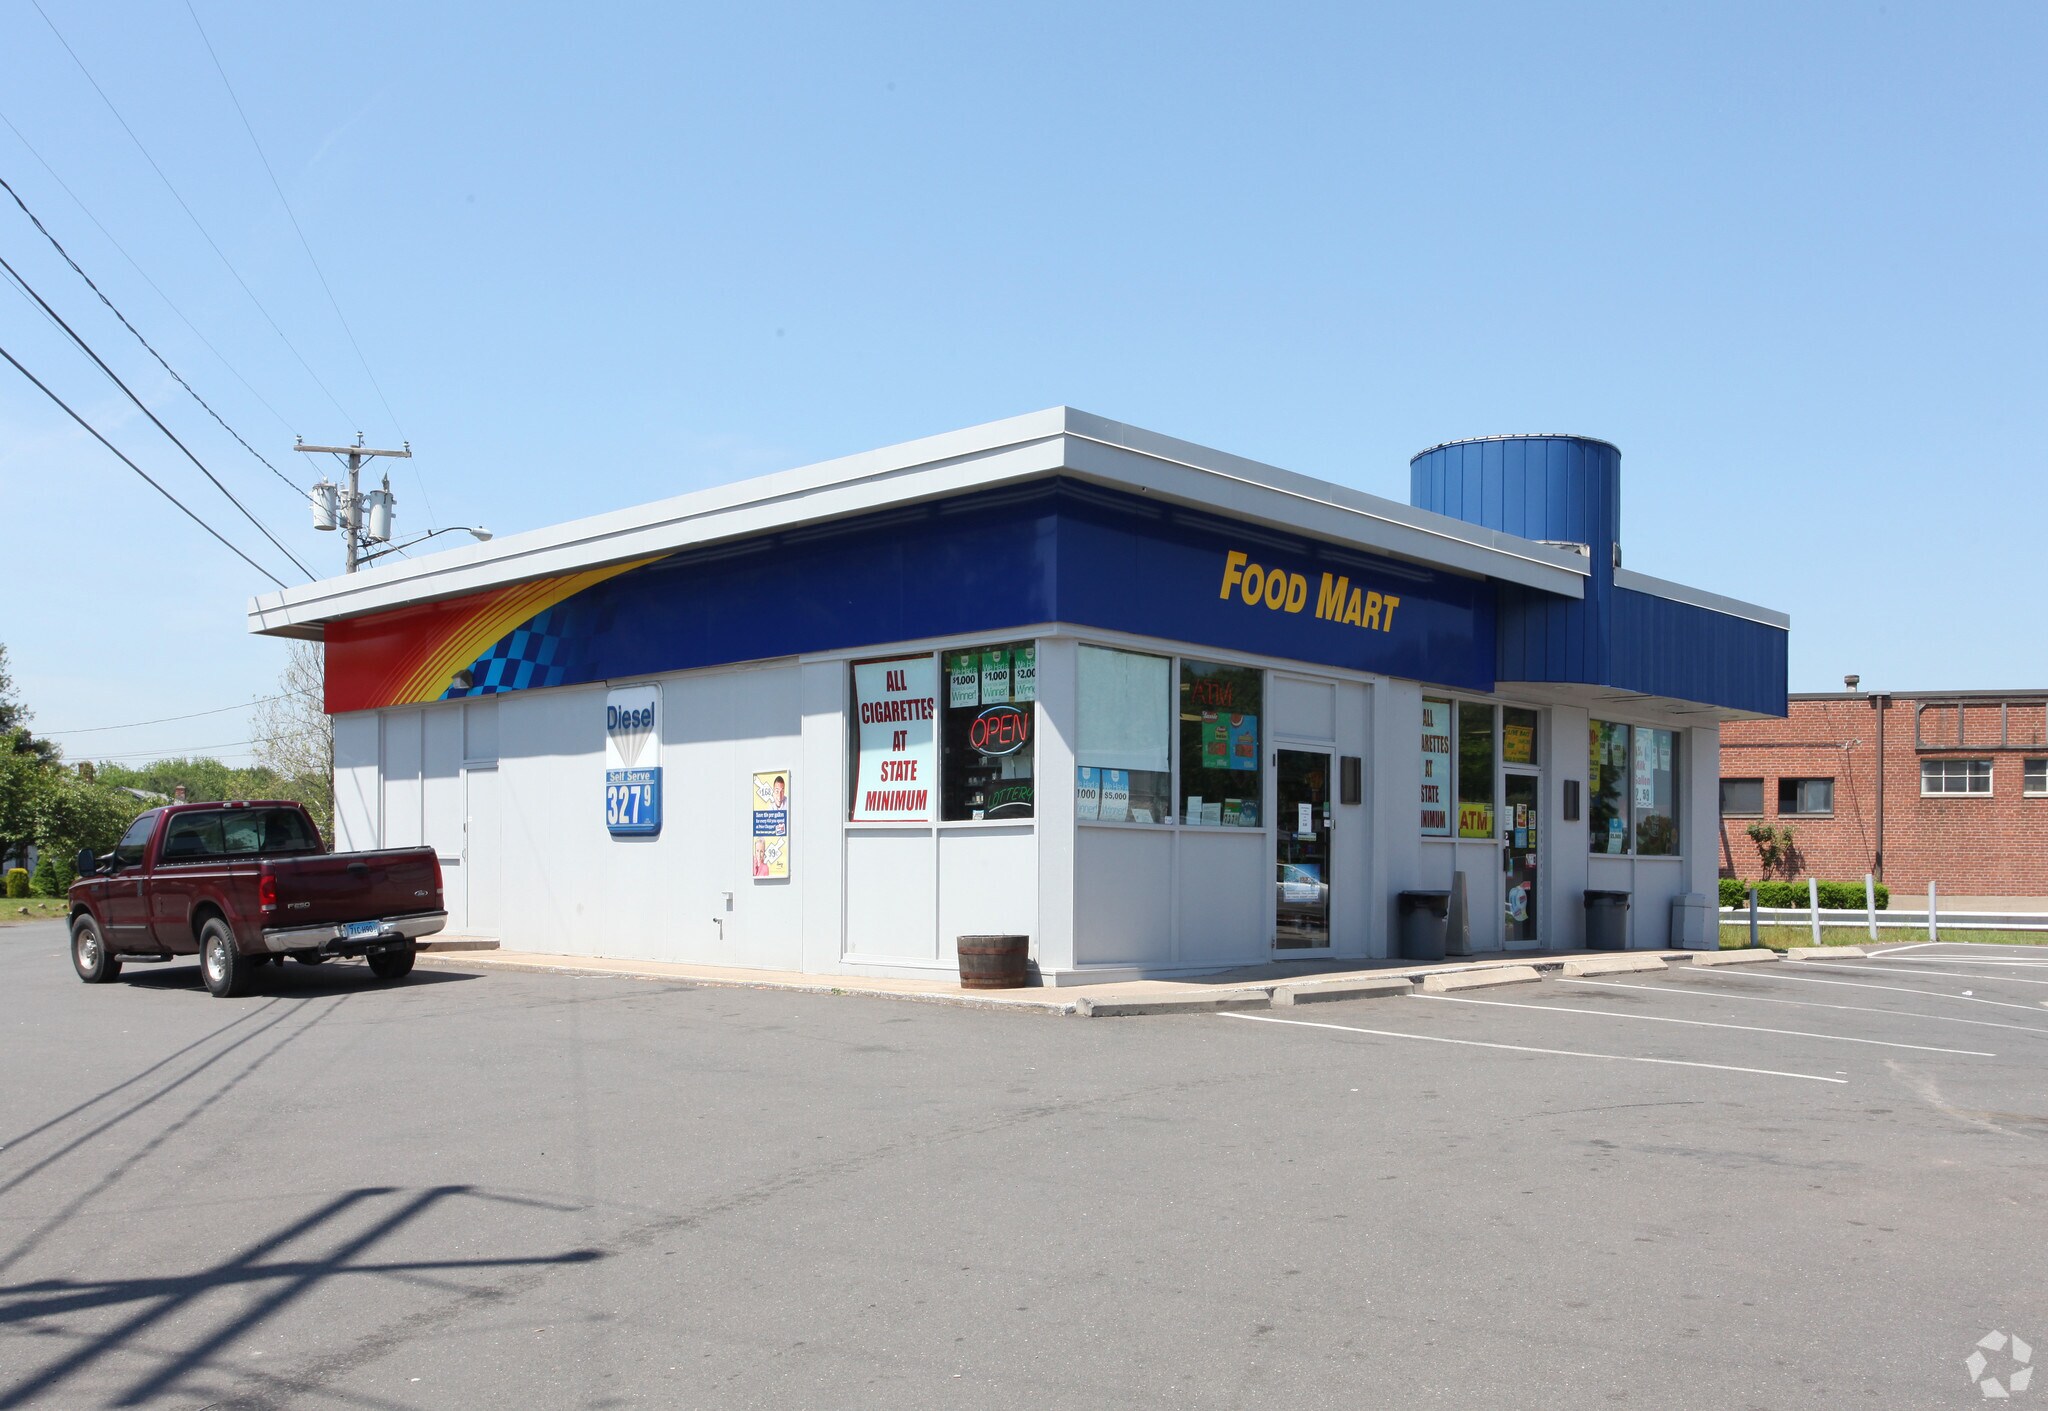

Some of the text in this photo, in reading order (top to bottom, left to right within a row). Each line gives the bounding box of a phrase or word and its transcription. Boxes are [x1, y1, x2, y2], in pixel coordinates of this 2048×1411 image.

[1219, 550, 1400, 633] FOOD MART
[886, 669, 907, 692] ALL
[983, 686, 1008, 697] Winner!
[952, 690, 977, 701] Winner!
[607, 701, 655, 730] Diesel
[861, 697, 934, 724] CIGARETTES
[1423, 708, 1434, 728] ALL
[892, 730, 908, 752] AT
[970, 713, 1028, 747] OPEN
[610, 770, 650, 782] Self Serve
[880, 760, 918, 782] STATE
[1425, 759, 1433, 778] AT
[865, 789, 928, 812] MINIMUM
[987, 785, 1034, 809] LOTTERY
[1104, 791, 1127, 801] $5,000
[1421, 784, 1439, 803] STATE
[1460, 810, 1488, 831] ATM
